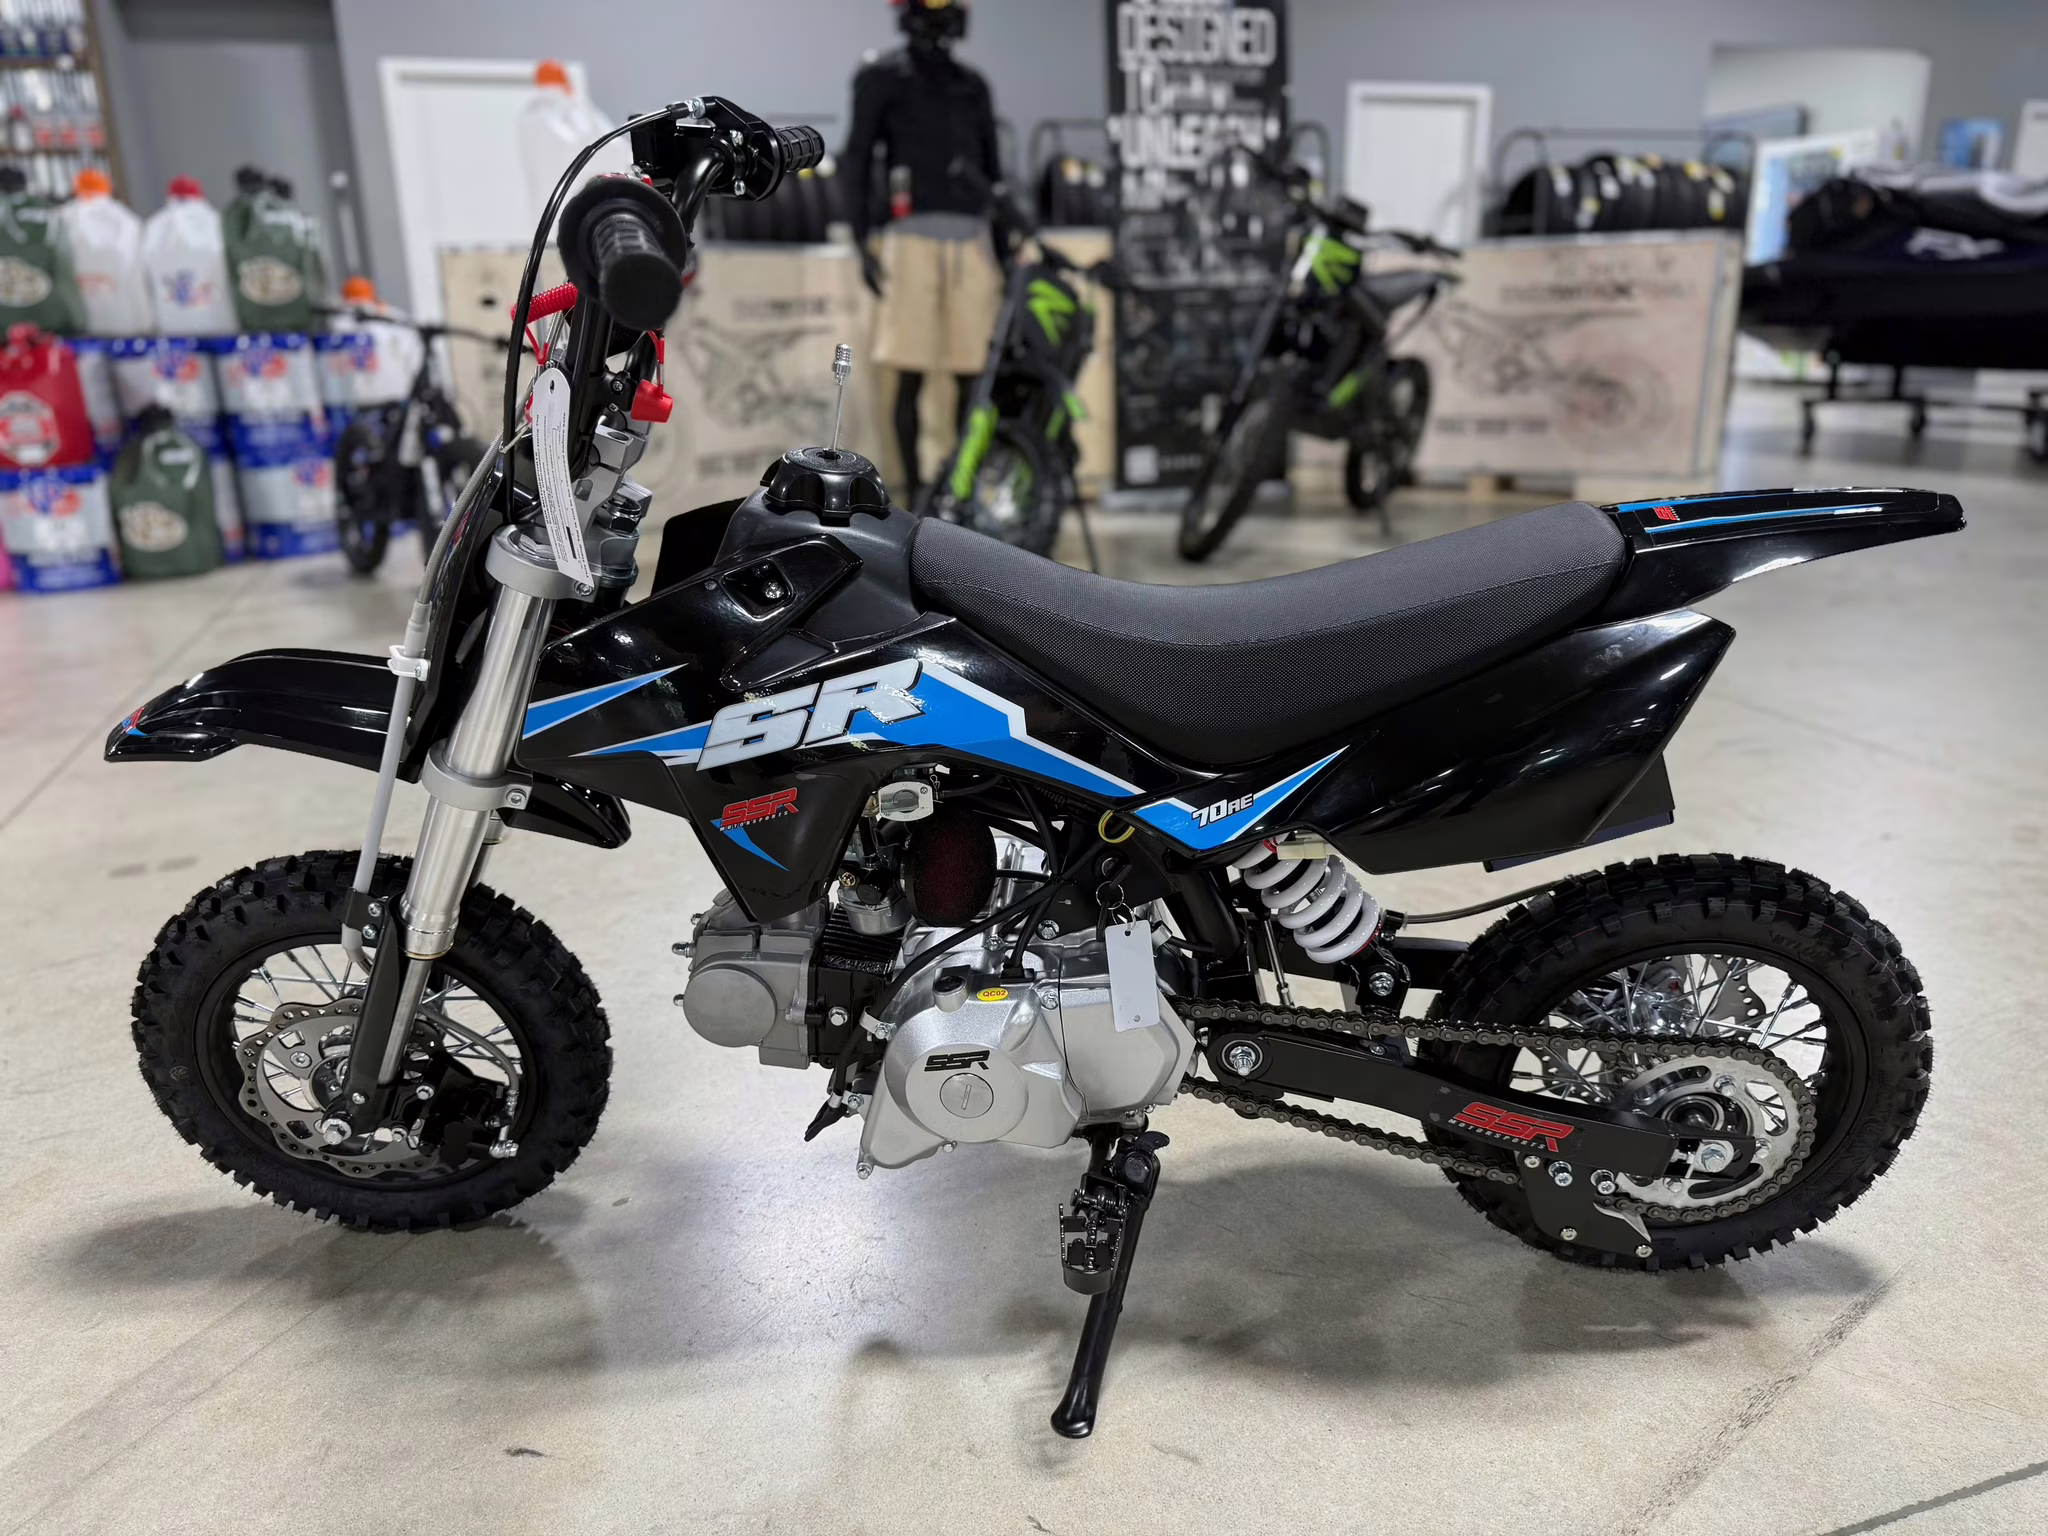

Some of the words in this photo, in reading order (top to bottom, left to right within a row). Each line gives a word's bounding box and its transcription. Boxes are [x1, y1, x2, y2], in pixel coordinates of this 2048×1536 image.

[719, 810, 790, 832] MOTORSPORTS
[720, 787, 799, 829] SSR
[1192, 793, 1257, 829] 70AE
[982, 988, 1007, 999] QC02
[924, 1050, 990, 1072] SSR
[1448, 1118, 1546, 1150] MOTORSPORTS
[1454, 1101, 1575, 1153] SSR
